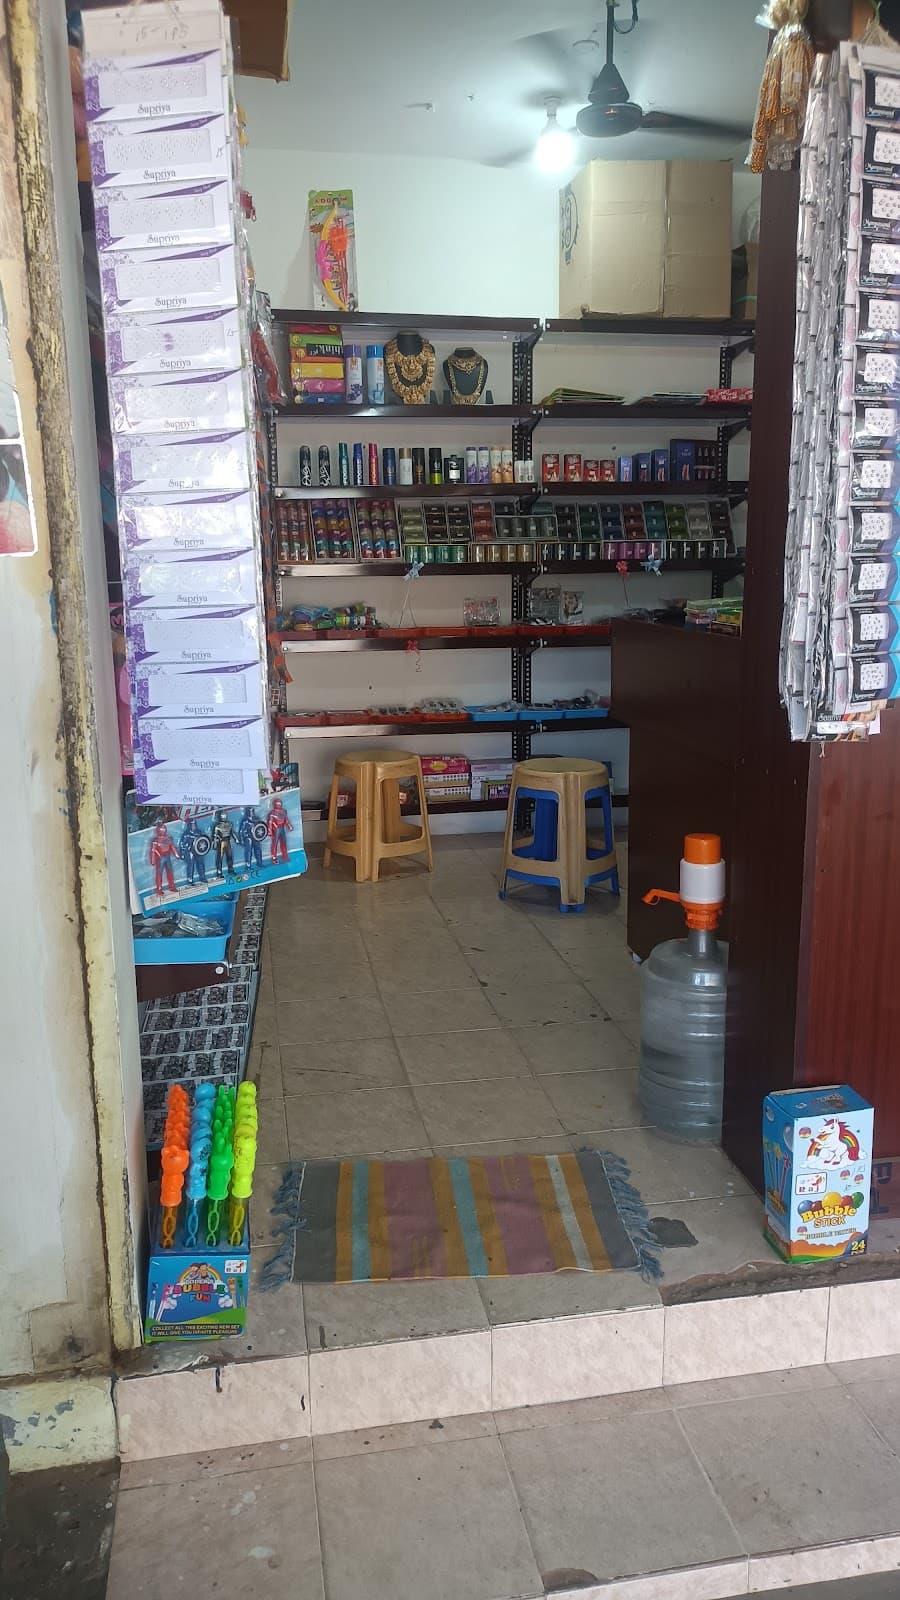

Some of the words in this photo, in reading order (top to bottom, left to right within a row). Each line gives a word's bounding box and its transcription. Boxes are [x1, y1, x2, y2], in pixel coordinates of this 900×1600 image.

[137, 103, 171, 115] Supriya
[143, 169, 176, 181] Supriya
[147, 234, 180, 245] Supriya
[154, 296, 187, 308] Supriya
[159, 359, 191, 369] Supriya
[163, 420, 195, 430] Supriya
[168, 479, 200, 489] Supya
[173, 538, 205, 548] Supriya
[176, 594, 208, 604] Supriya
[181, 651, 212, 660] Supriya
[183, 705, 214, 715] Supriya
[189, 759, 220, 769] Supriya
[182, 794, 212, 804] Supriya
[801, 1205, 857, 1223] Bubble
[814, 1216, 846, 1228] STICK
[851, 1240, 866, 1251] 24
